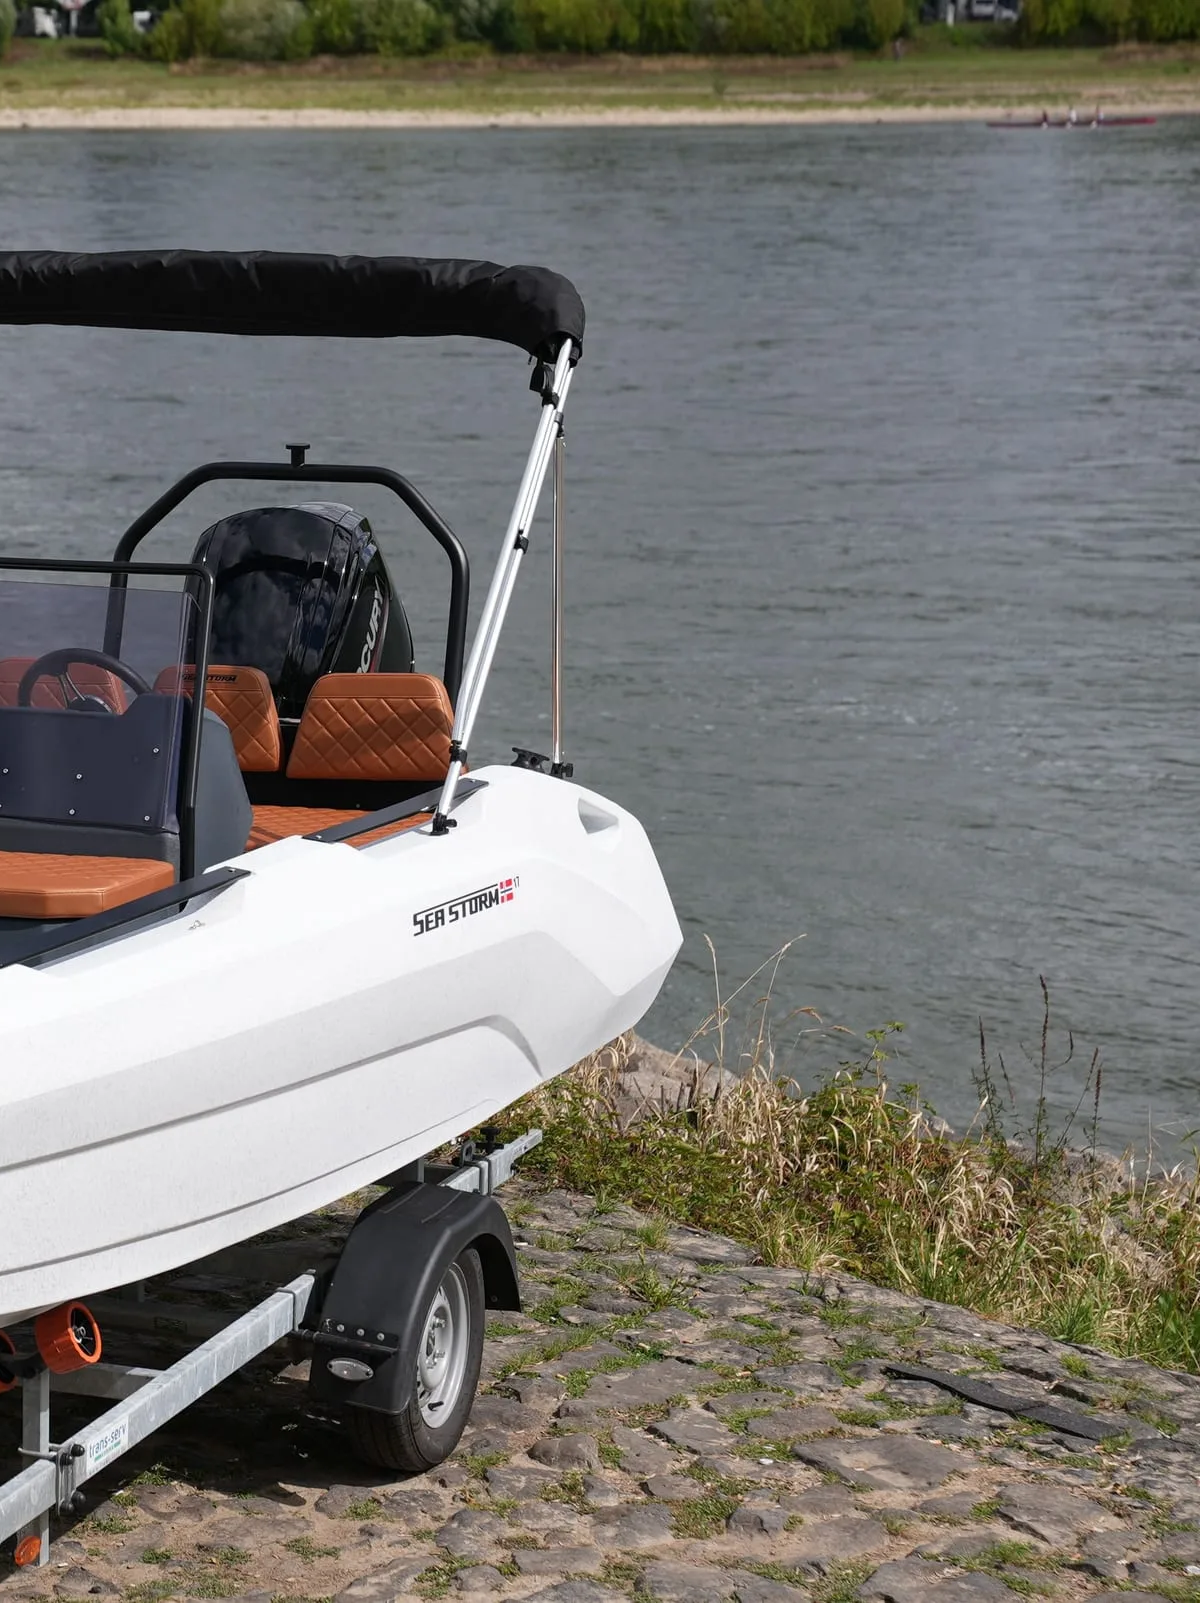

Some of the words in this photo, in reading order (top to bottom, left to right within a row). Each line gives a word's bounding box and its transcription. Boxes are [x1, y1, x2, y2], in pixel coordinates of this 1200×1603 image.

[354, 577, 383, 673] CURY
[413, 906, 446, 937] SEA
[448, 886, 499, 923] STORM
[89, 1423, 127, 1459] trans-serv
